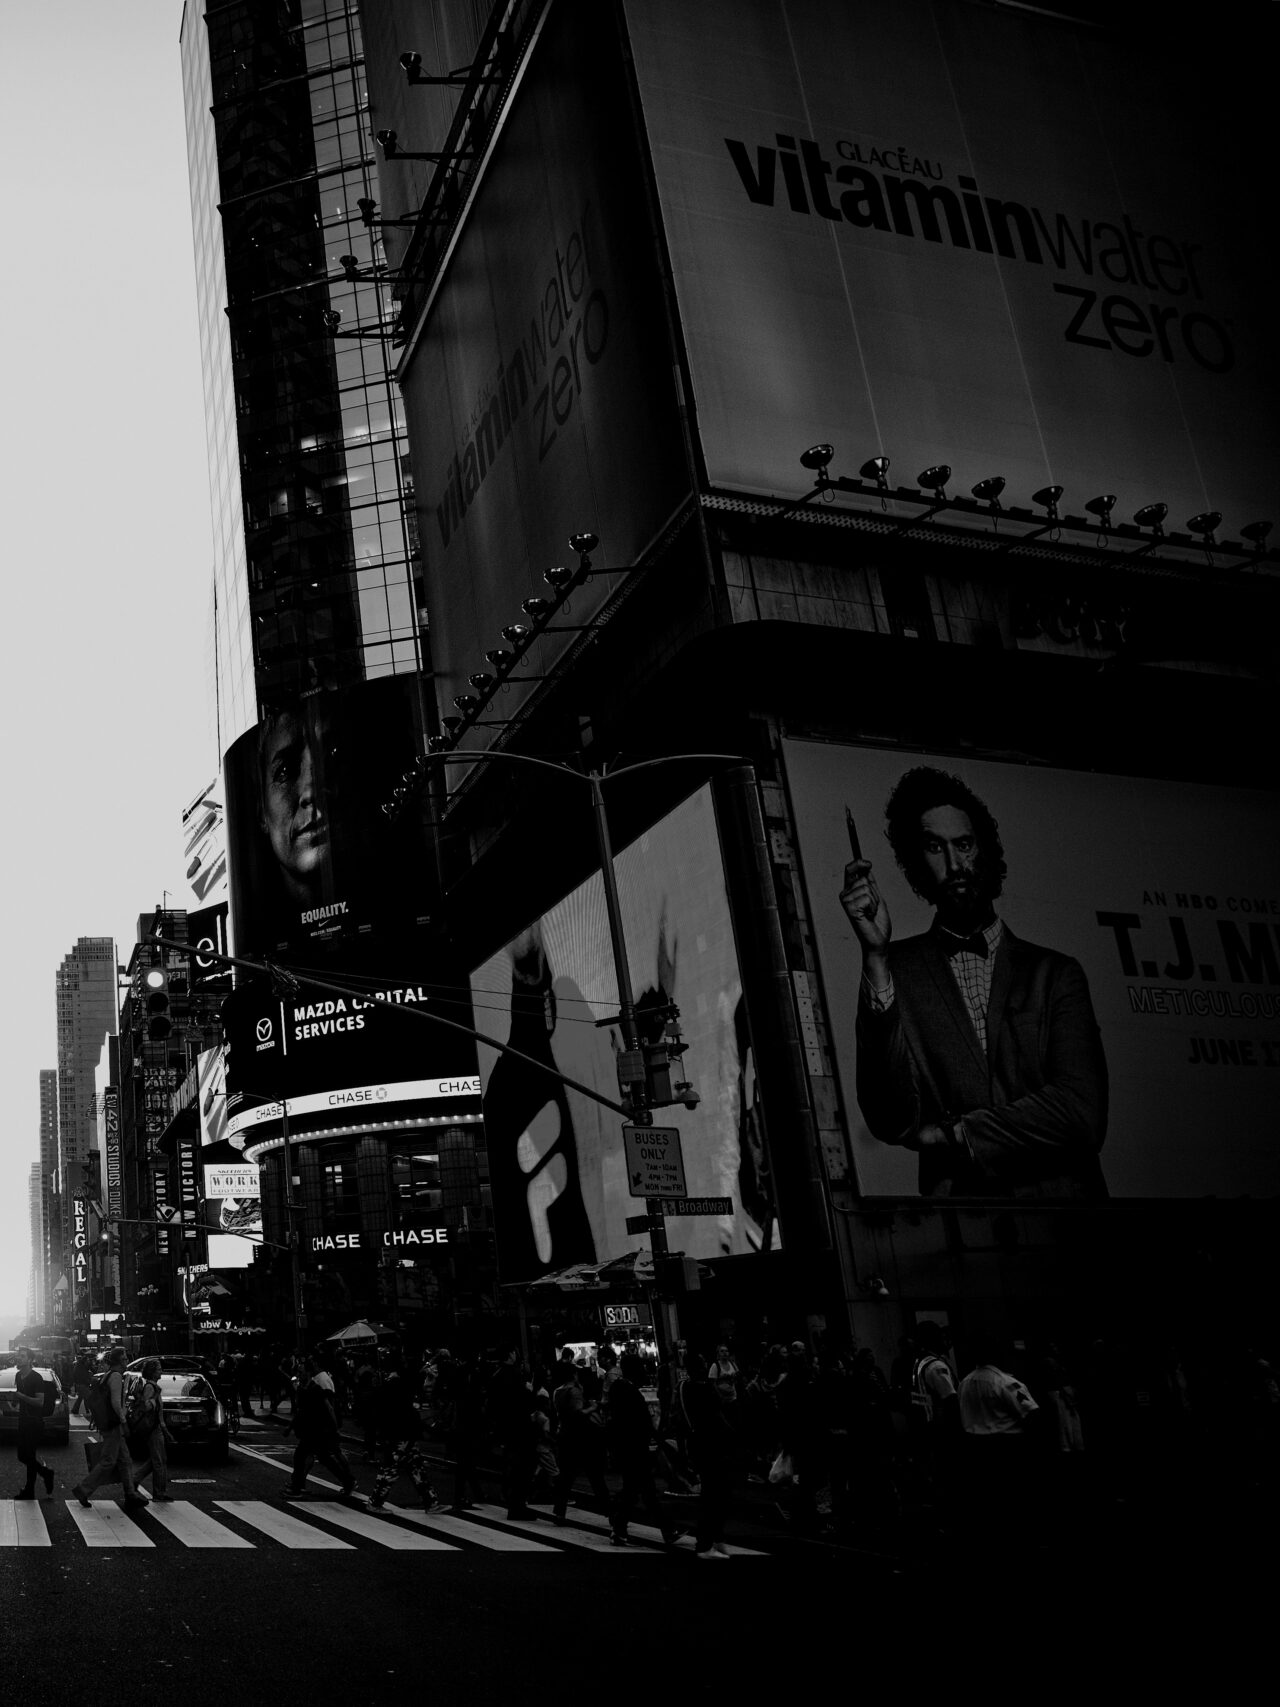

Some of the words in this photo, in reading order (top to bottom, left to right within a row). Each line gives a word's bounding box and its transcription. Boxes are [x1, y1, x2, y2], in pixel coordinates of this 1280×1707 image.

[724, 134, 1202, 300] vitaminwater
[1053, 283, 1236, 374] zero
[436, 198, 591, 549] vitaminwater
[533, 288, 609, 464] zero
[1142, 890, 1167, 906] AN
[1175, 893, 1218, 910] HBO
[301, 901, 350, 925] EQUALITY.
[1096, 911, 1217, 981] T.J.
[1216, 919, 1280, 985] M
[293, 1000, 348, 1023] MAZDA
[294, 1014, 366, 1041] SERVICES
[1188, 1037, 1258, 1066] JUNE
[256, 1105, 283, 1120] CHASE
[328, 1089, 373, 1106] CHASE
[438, 1078, 482, 1094] CHAS
[107, 1109, 118, 1132] 42
[634, 1133, 669, 1145] BUSES
[108, 1145, 121, 1186] STUDIOS
[640, 1148, 666, 1160] ONLY
[181, 1142, 196, 1202] VICTORY
[212, 1176, 258, 1186] WORK
[645, 1183, 659, 1191] MON
[110, 1190, 122, 1216] DUKE
[679, 1200, 730, 1214] Broadway
[73, 1200, 87, 1282] REGAL
[157, 1229, 169, 1254] NEW
[312, 1233, 361, 1251] CHASE
[383, 1228, 449, 1246] CHASE
[200, 1319, 232, 1329] ubwy
[606, 1307, 639, 1324] SODA
